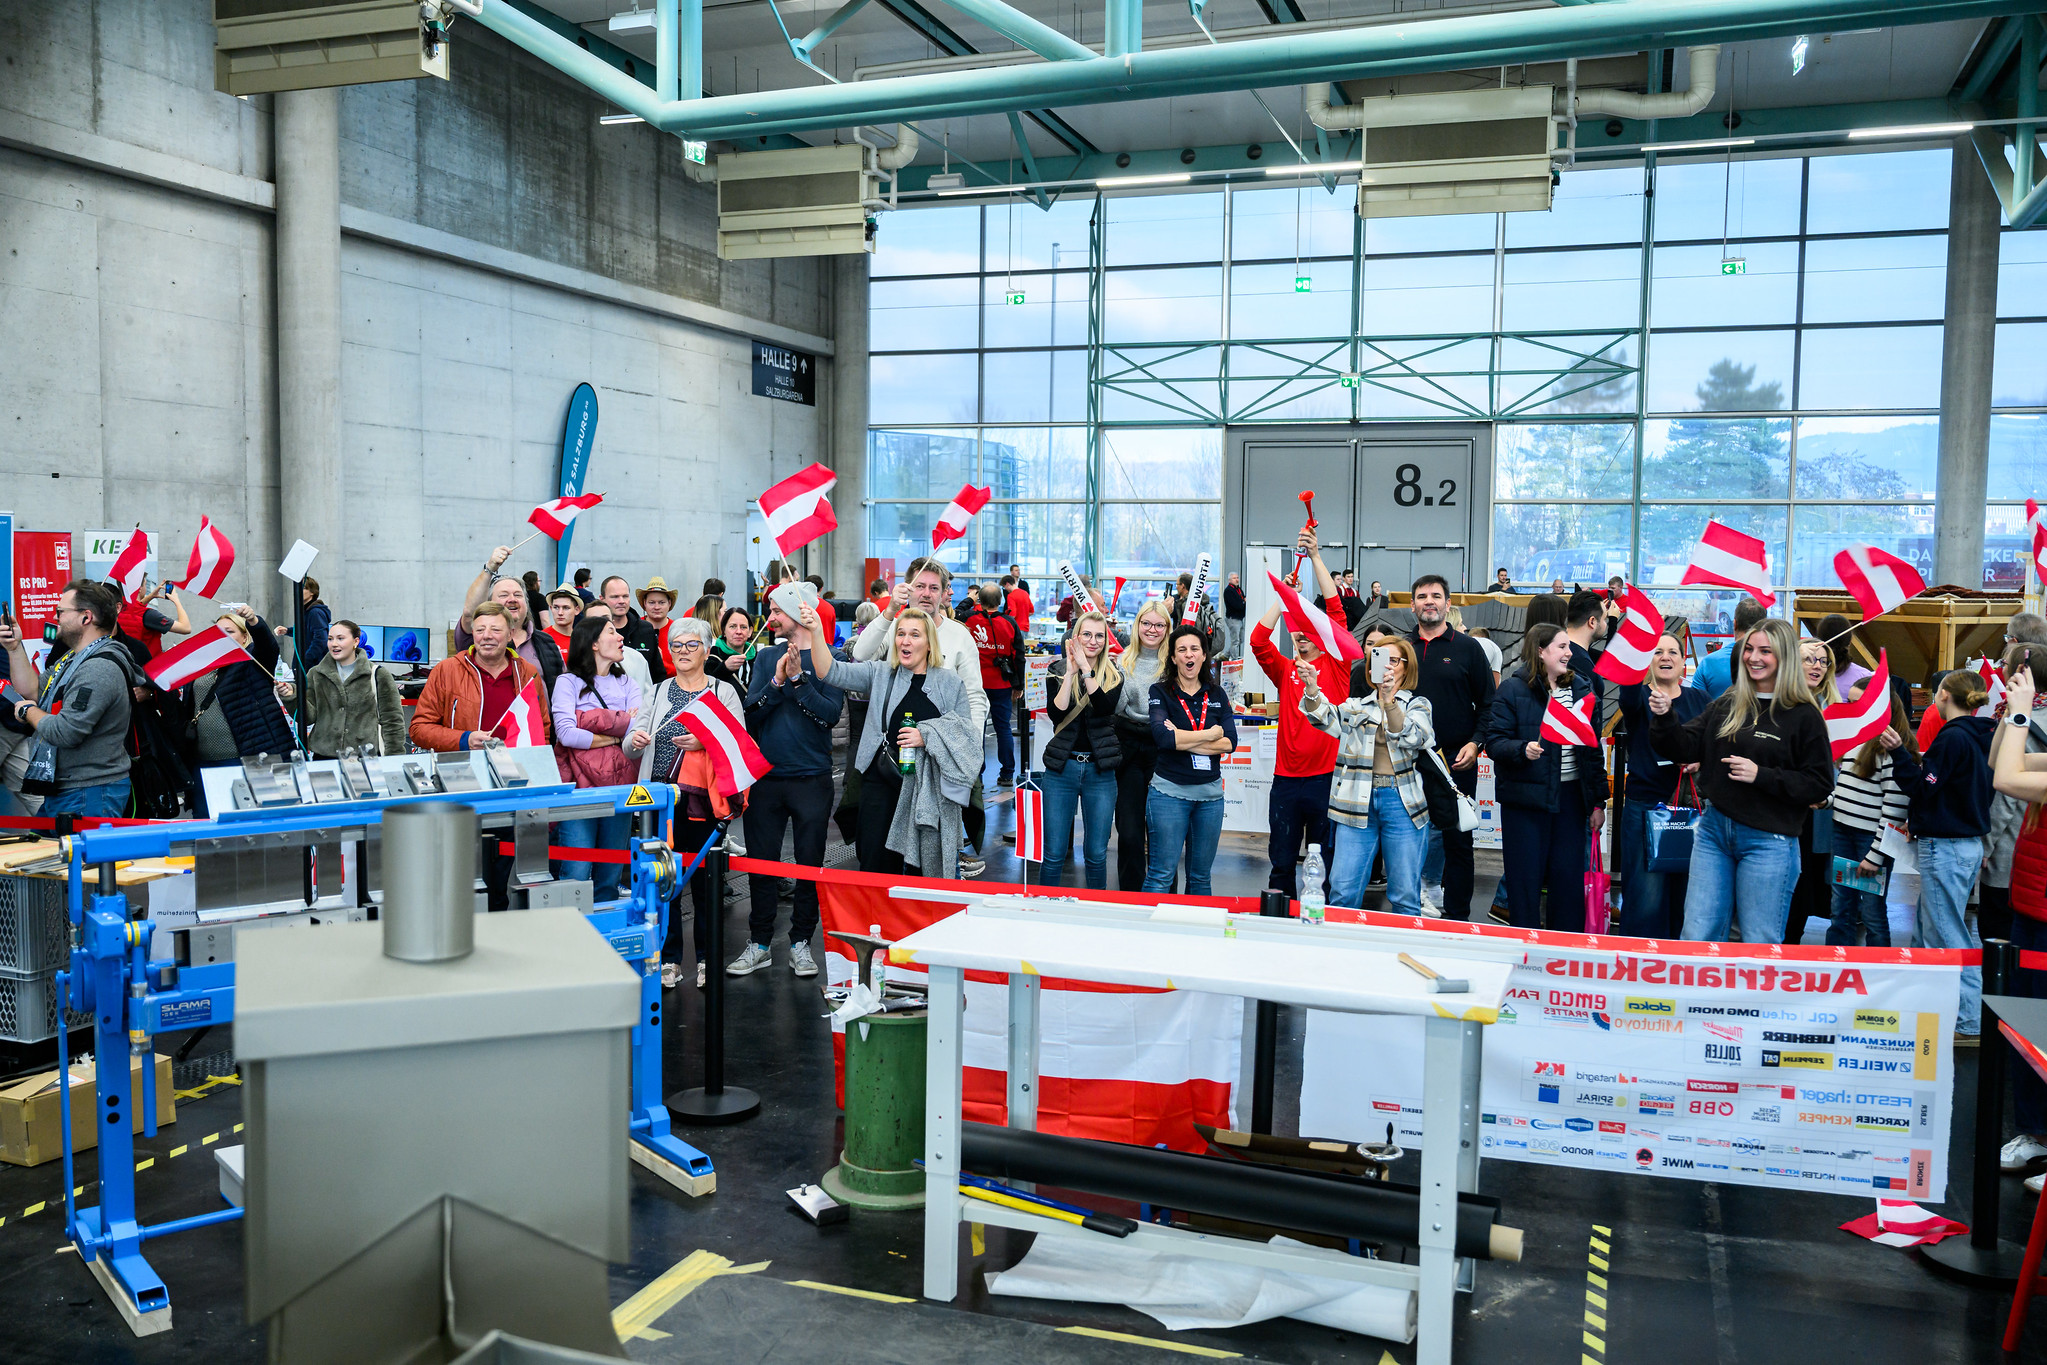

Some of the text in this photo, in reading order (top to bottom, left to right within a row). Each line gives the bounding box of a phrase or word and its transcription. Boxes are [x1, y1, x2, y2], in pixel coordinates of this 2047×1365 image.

[761, 347, 797, 372] HALLE 9
[775, 375, 788, 386] HALLE
[766, 386, 803, 402] SALZBURGARENA
[571, 412, 588, 480] SALZBURG
[1394, 464, 1456, 506] 8.2
[57, 546, 67, 557] RS
[1194, 559, 1210, 599] WÜRTH
[1571, 565, 1593, 579] ZOLLER
[20, 578, 30, 588] RS
[32, 577, 46, 588] PRO
[1060, 565, 1086, 602] WÜRTH
[162, 999, 210, 1012] SLAMA
